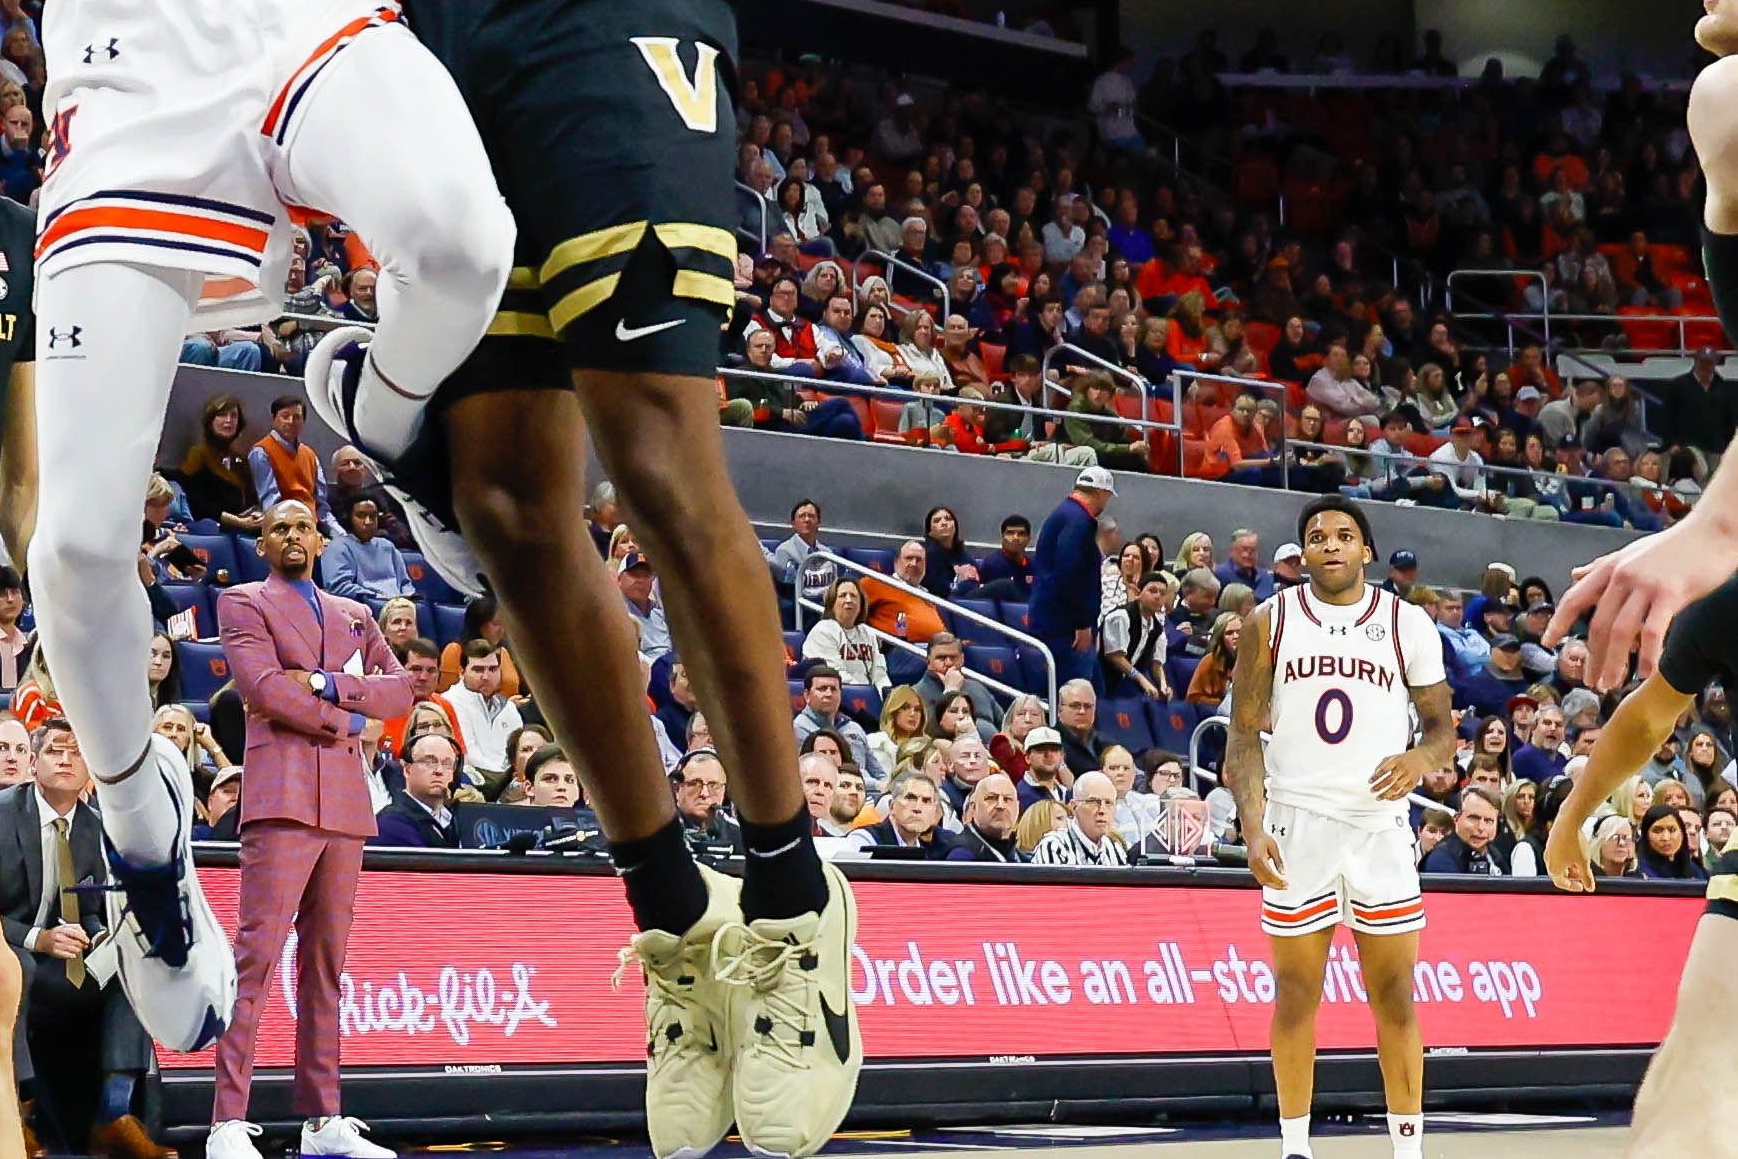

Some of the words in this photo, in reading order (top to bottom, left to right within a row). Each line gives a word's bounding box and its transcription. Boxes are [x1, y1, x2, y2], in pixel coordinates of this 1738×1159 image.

[629, 36, 720, 133] V
[1283, 655, 1395, 693] AUBURN
[1314, 688, 1354, 745] 0
[982, 941, 1073, 1006] like
[1079, 959, 1138, 1006] an
[1142, 941, 1276, 1005] all-sta
[1467, 959, 1542, 1019] app
